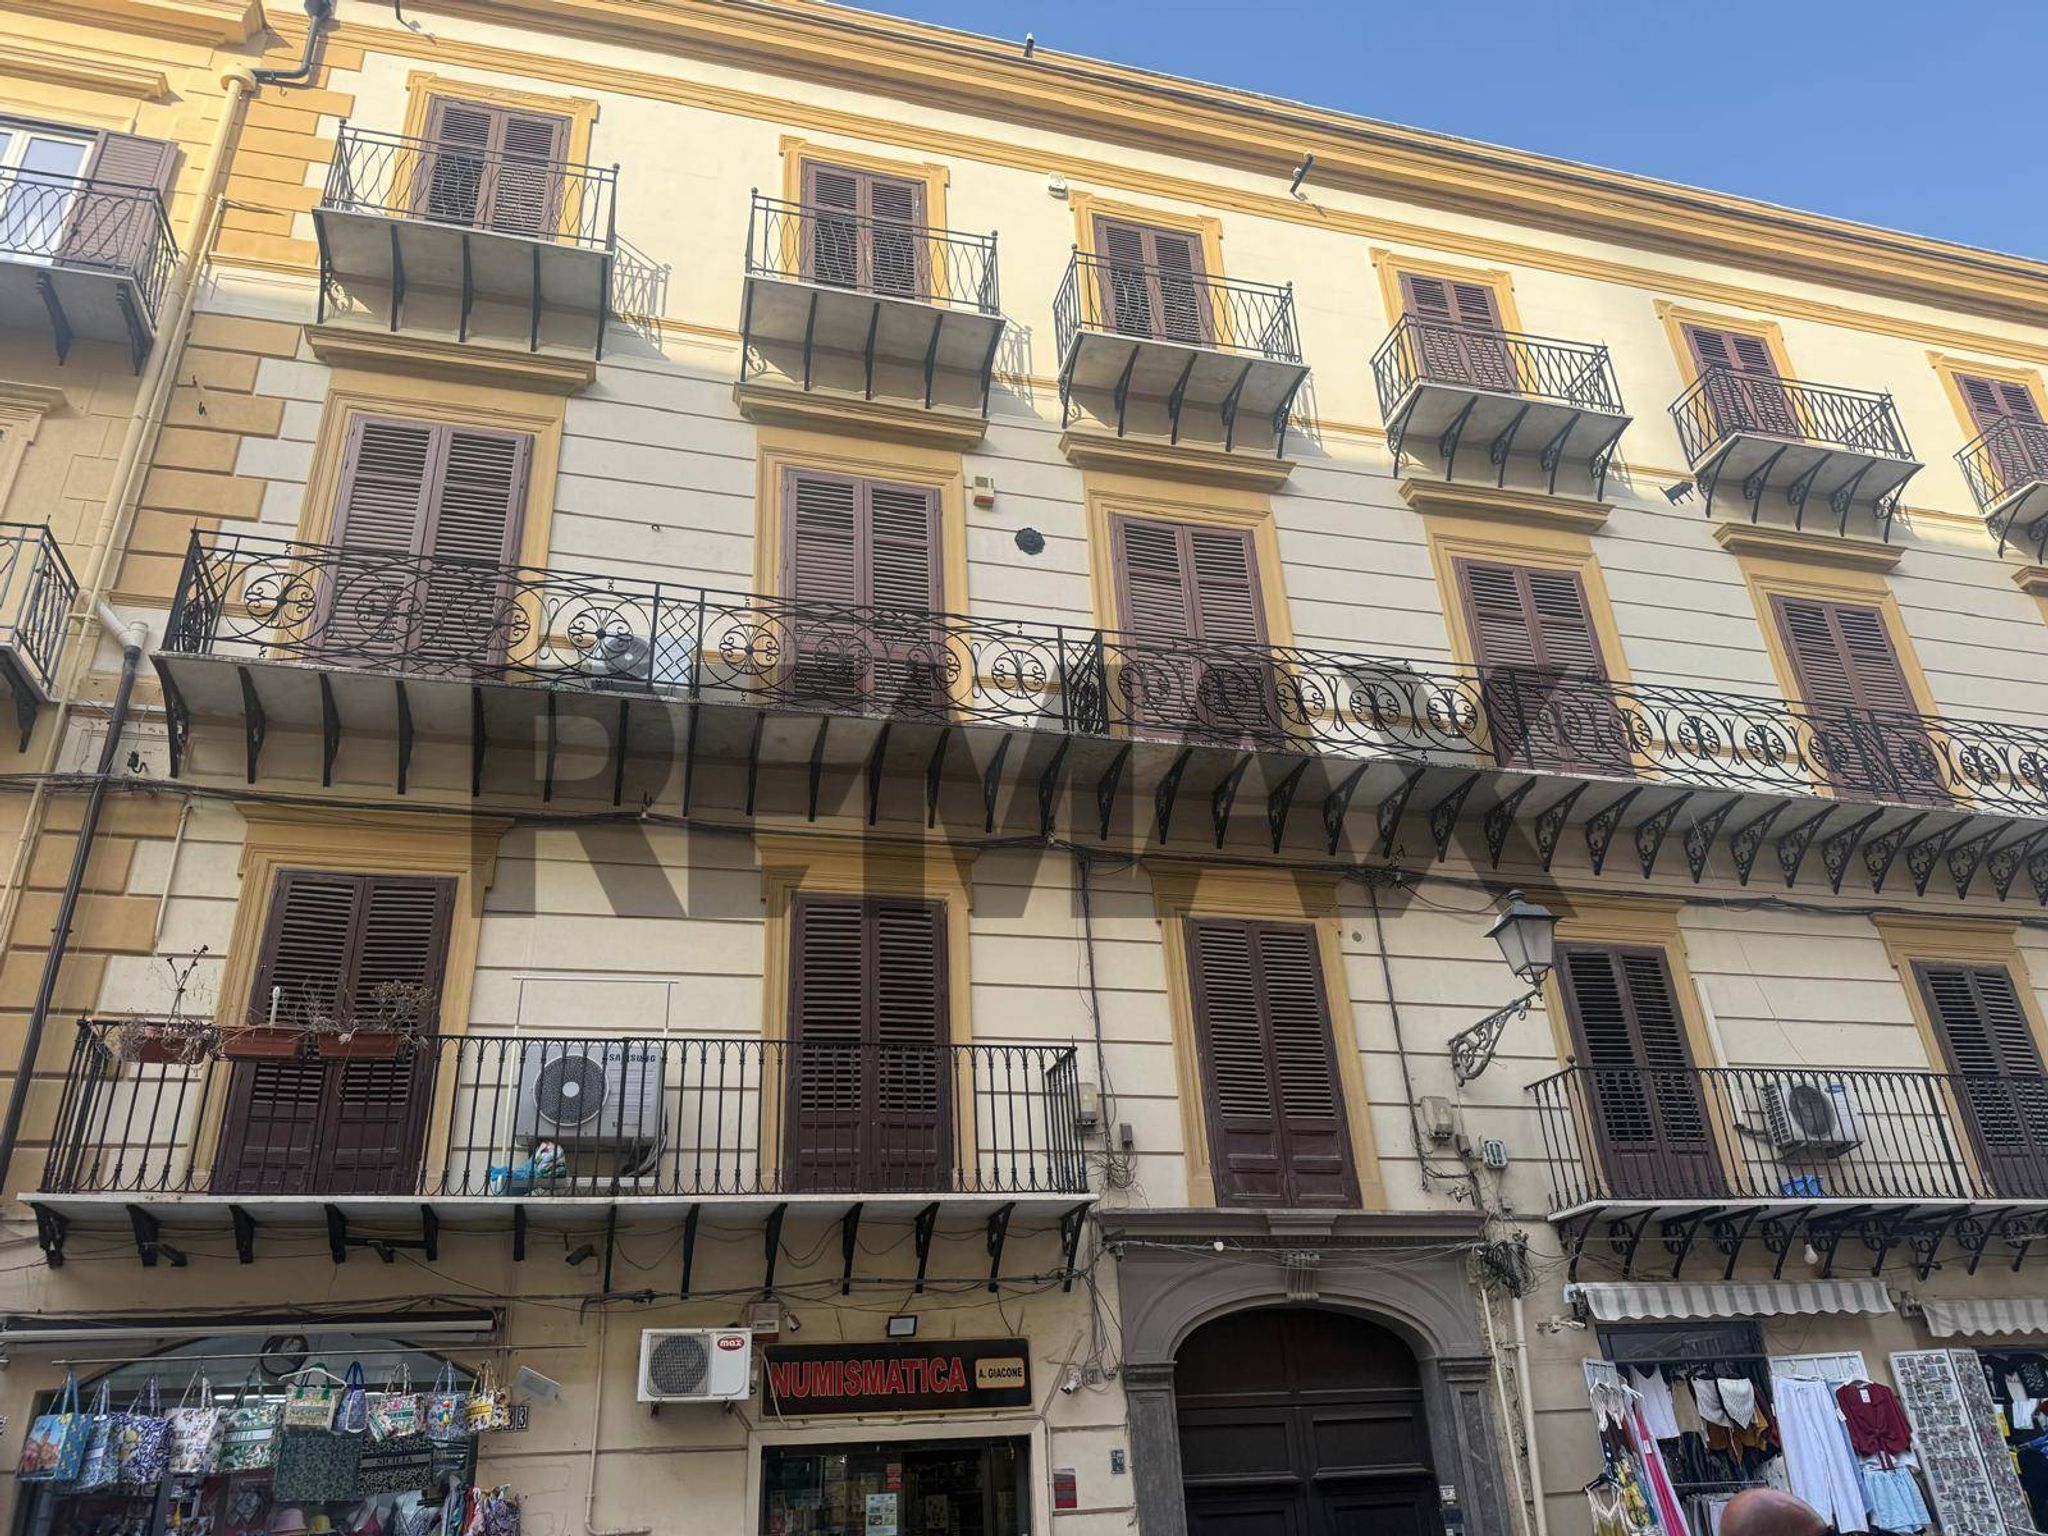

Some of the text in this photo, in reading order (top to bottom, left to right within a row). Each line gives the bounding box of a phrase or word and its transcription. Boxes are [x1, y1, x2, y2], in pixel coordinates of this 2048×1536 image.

[609, 1053, 656, 1063] SASUG
[770, 1356, 968, 1397] NUMISMATICA
[978, 1367, 1022, 1379] A. GIACONE
